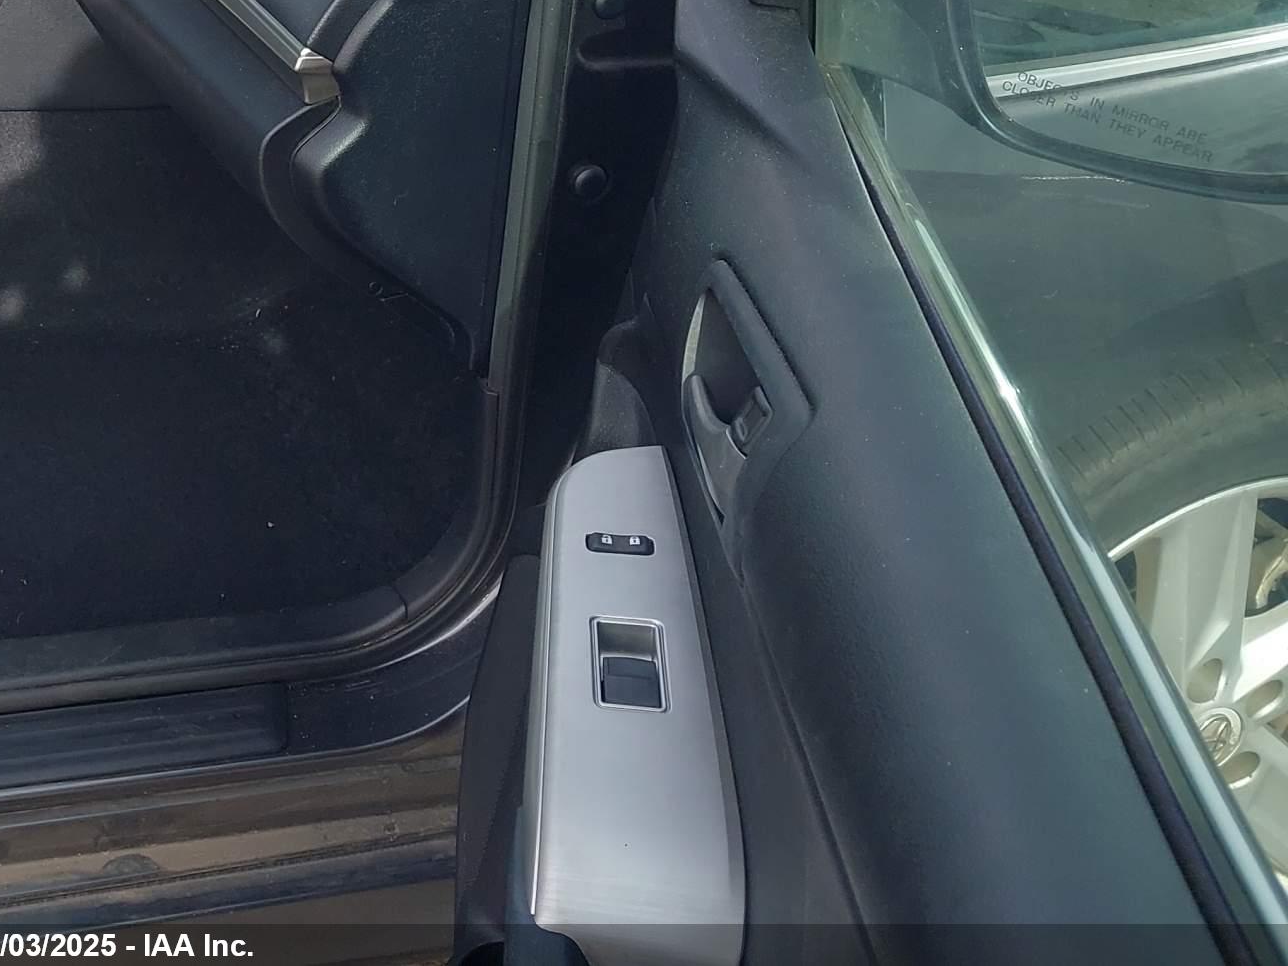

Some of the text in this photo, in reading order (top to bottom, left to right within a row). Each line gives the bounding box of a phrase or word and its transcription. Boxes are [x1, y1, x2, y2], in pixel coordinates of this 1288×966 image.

[1017, 71, 1208, 145] OBJECS IN MIRROR ARE
[1063, 102, 1103, 125] THAN
[1108, 118, 1147, 139] THEY
[1152, 134, 1214, 163] APPEAR
